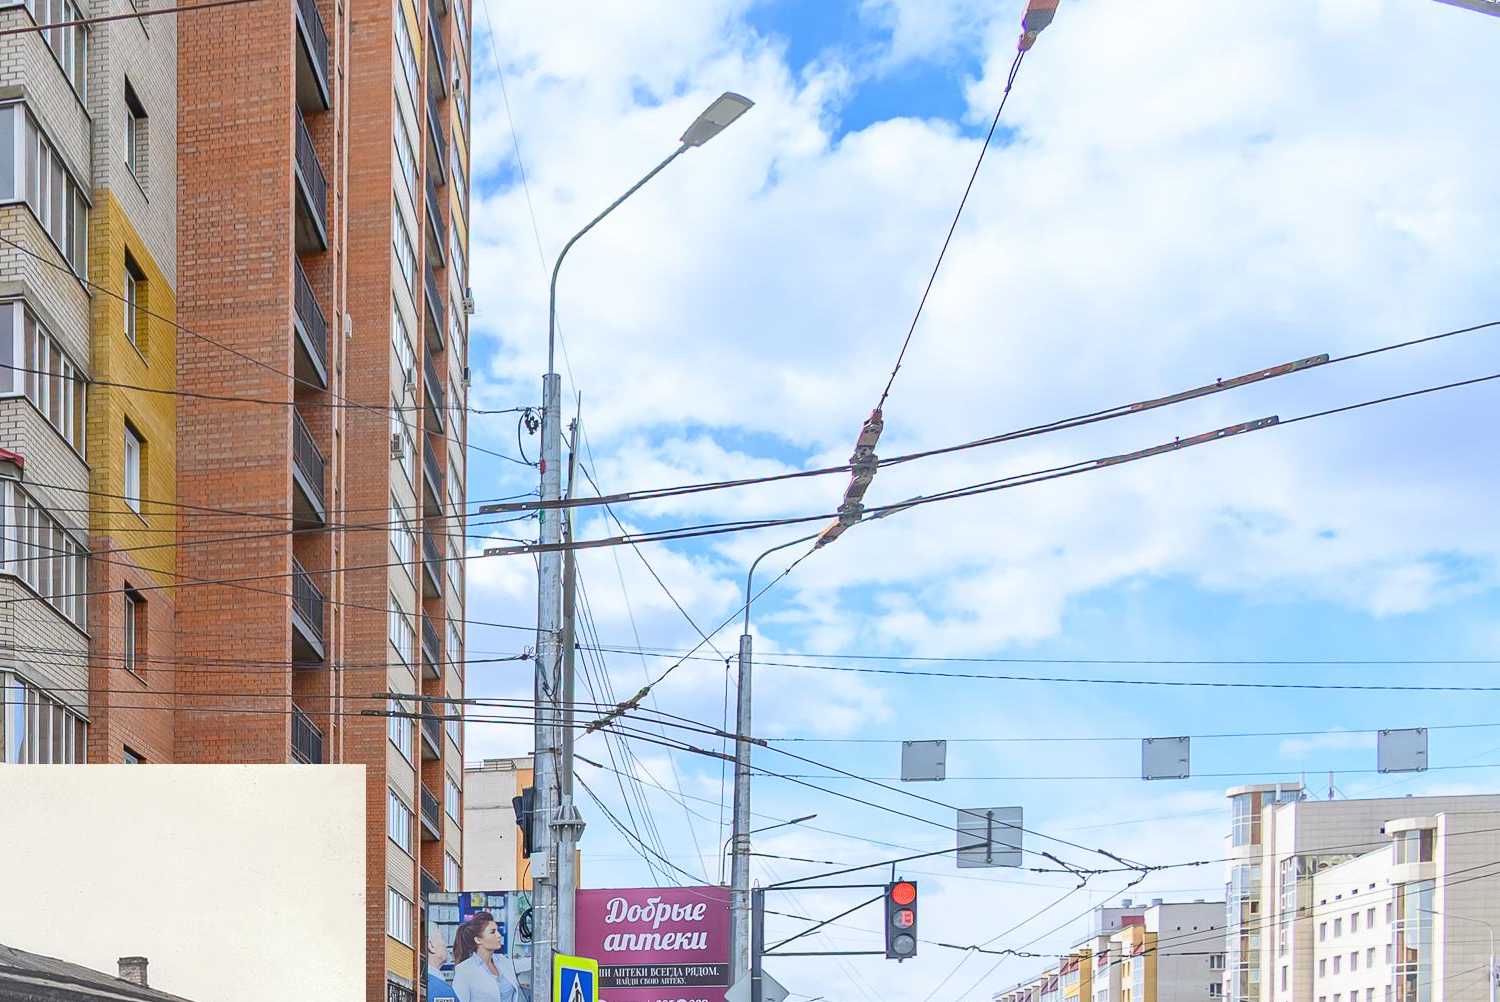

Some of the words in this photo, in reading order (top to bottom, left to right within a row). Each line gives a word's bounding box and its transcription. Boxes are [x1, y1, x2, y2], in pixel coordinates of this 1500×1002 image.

[604, 896, 707, 930] Добрые
[603, 931, 708, 952] аптеки
[613, 968, 648, 977] АПТЕКИ
[650, 967, 683, 978] ВСЕГДА
[685, 967, 720, 977] РЯДОМ.
[616, 977, 639, 986] НАЙДИ
